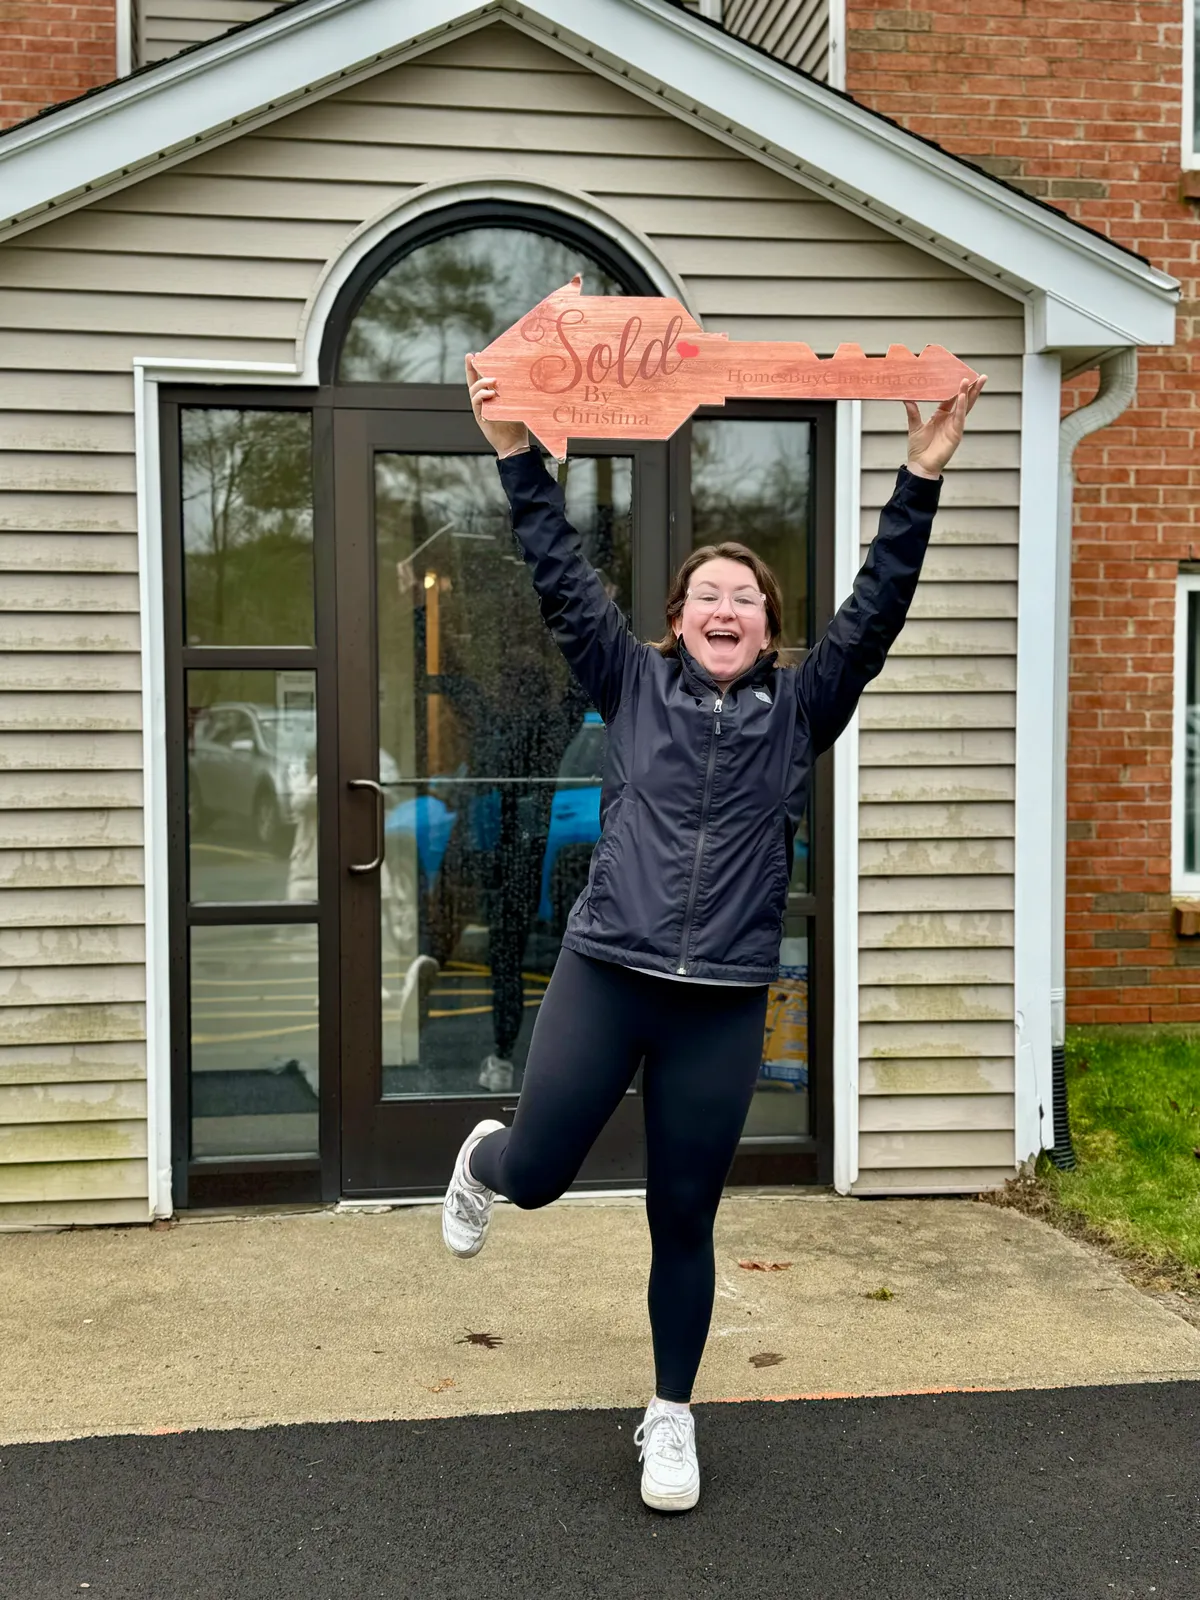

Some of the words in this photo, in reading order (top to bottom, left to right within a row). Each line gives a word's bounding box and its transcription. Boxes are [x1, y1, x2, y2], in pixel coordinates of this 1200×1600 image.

[521, 309, 684, 394] Sold
[583, 385, 613, 406] By
[552, 405, 650, 426] Christina
